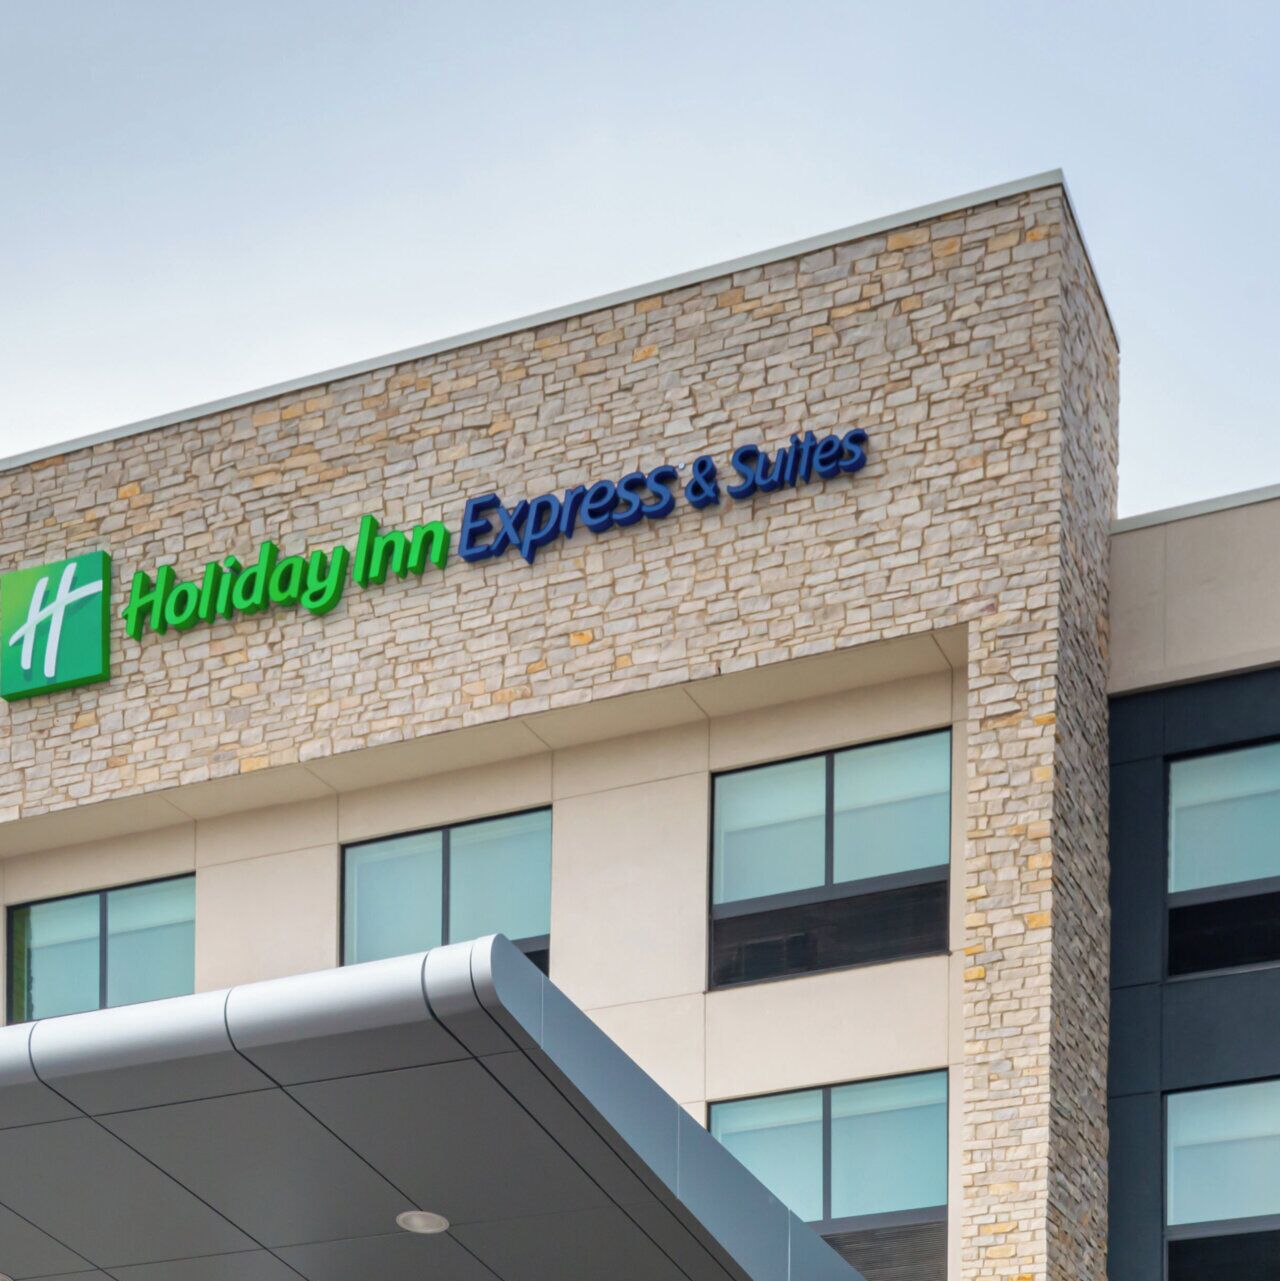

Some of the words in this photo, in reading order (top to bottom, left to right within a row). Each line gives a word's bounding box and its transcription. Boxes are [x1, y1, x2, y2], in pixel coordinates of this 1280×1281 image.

[121, 541, 349, 642] Holiday
[353, 515, 452, 589] Inn
[458, 465, 679, 564] Express
[684, 455, 720, 510] &
[727, 428, 869, 500] Suites
